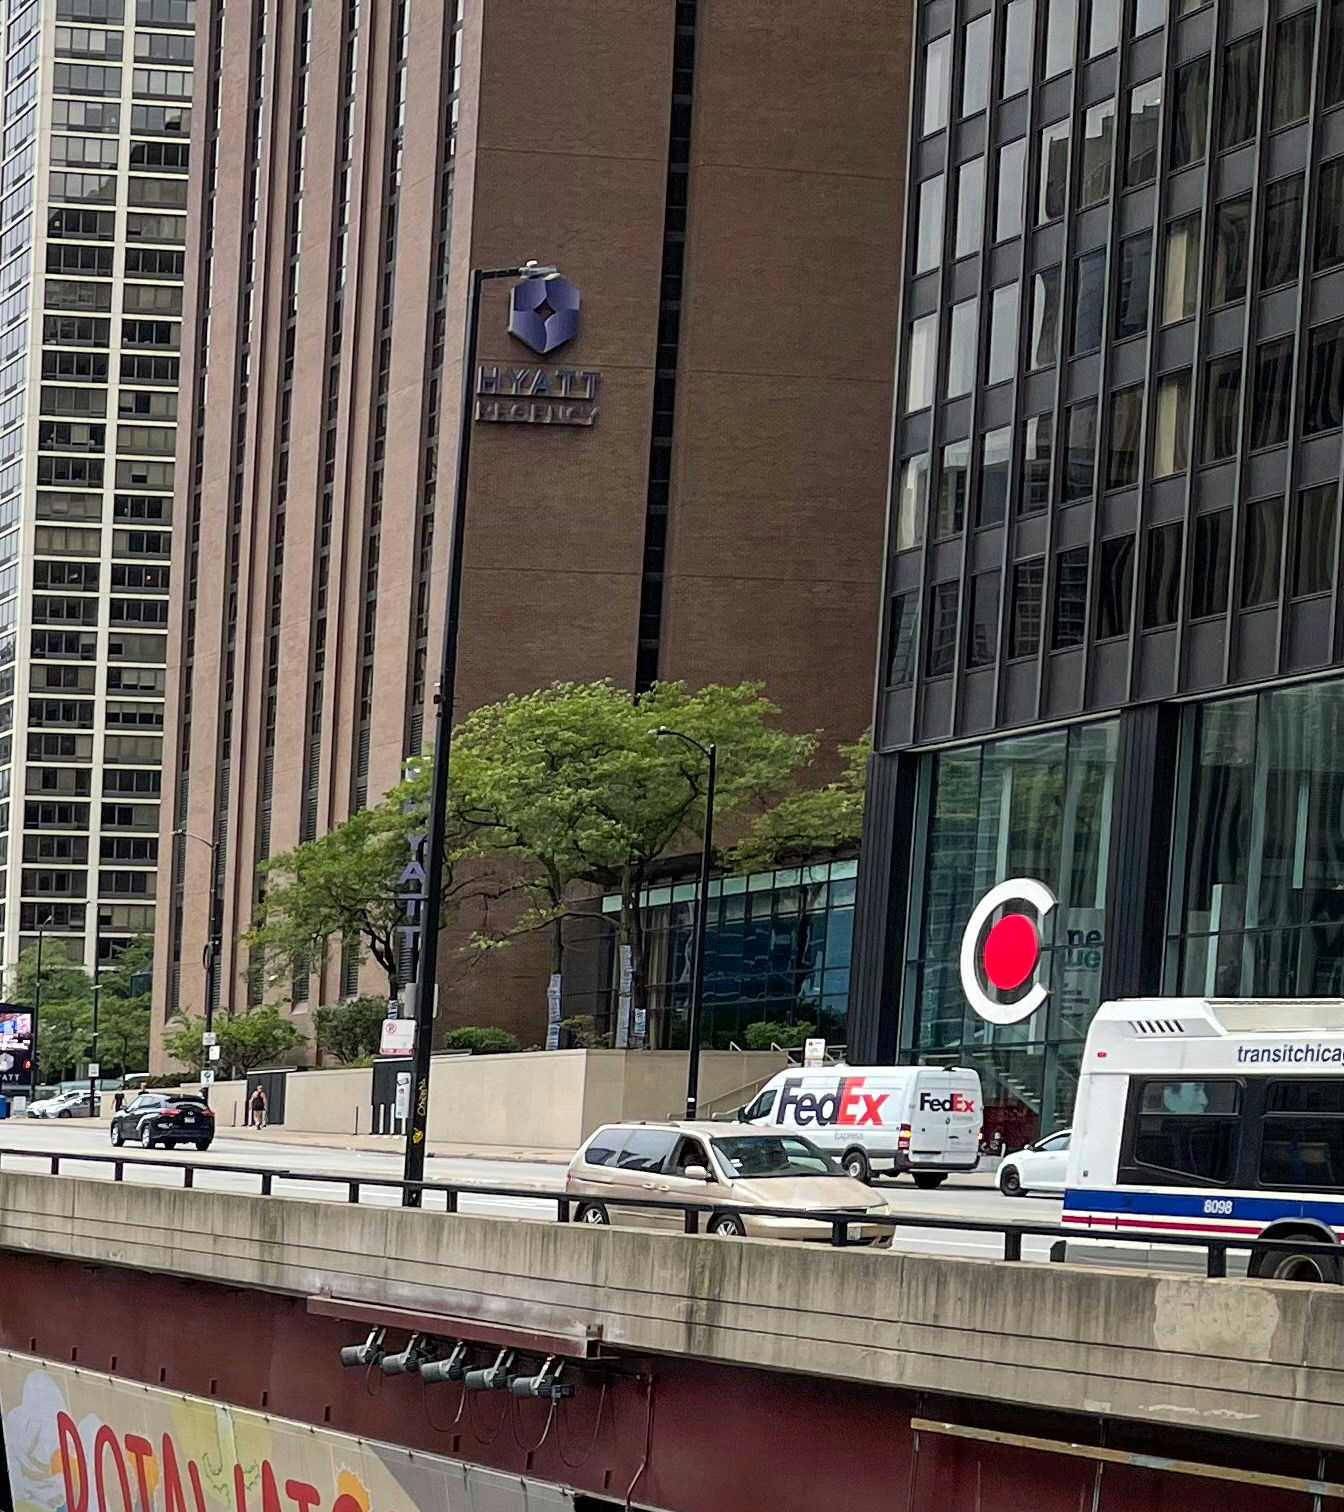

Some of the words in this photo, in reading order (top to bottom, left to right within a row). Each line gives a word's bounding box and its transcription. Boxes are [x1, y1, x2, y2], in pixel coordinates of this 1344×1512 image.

[477, 366, 602, 398] HYATT
[1237, 1043, 1344, 1067] transitchica
[776, 1076, 889, 1126] FedEx
[920, 1092, 975, 1113] FedEx
[1203, 1199, 1233, 1215] 8098
